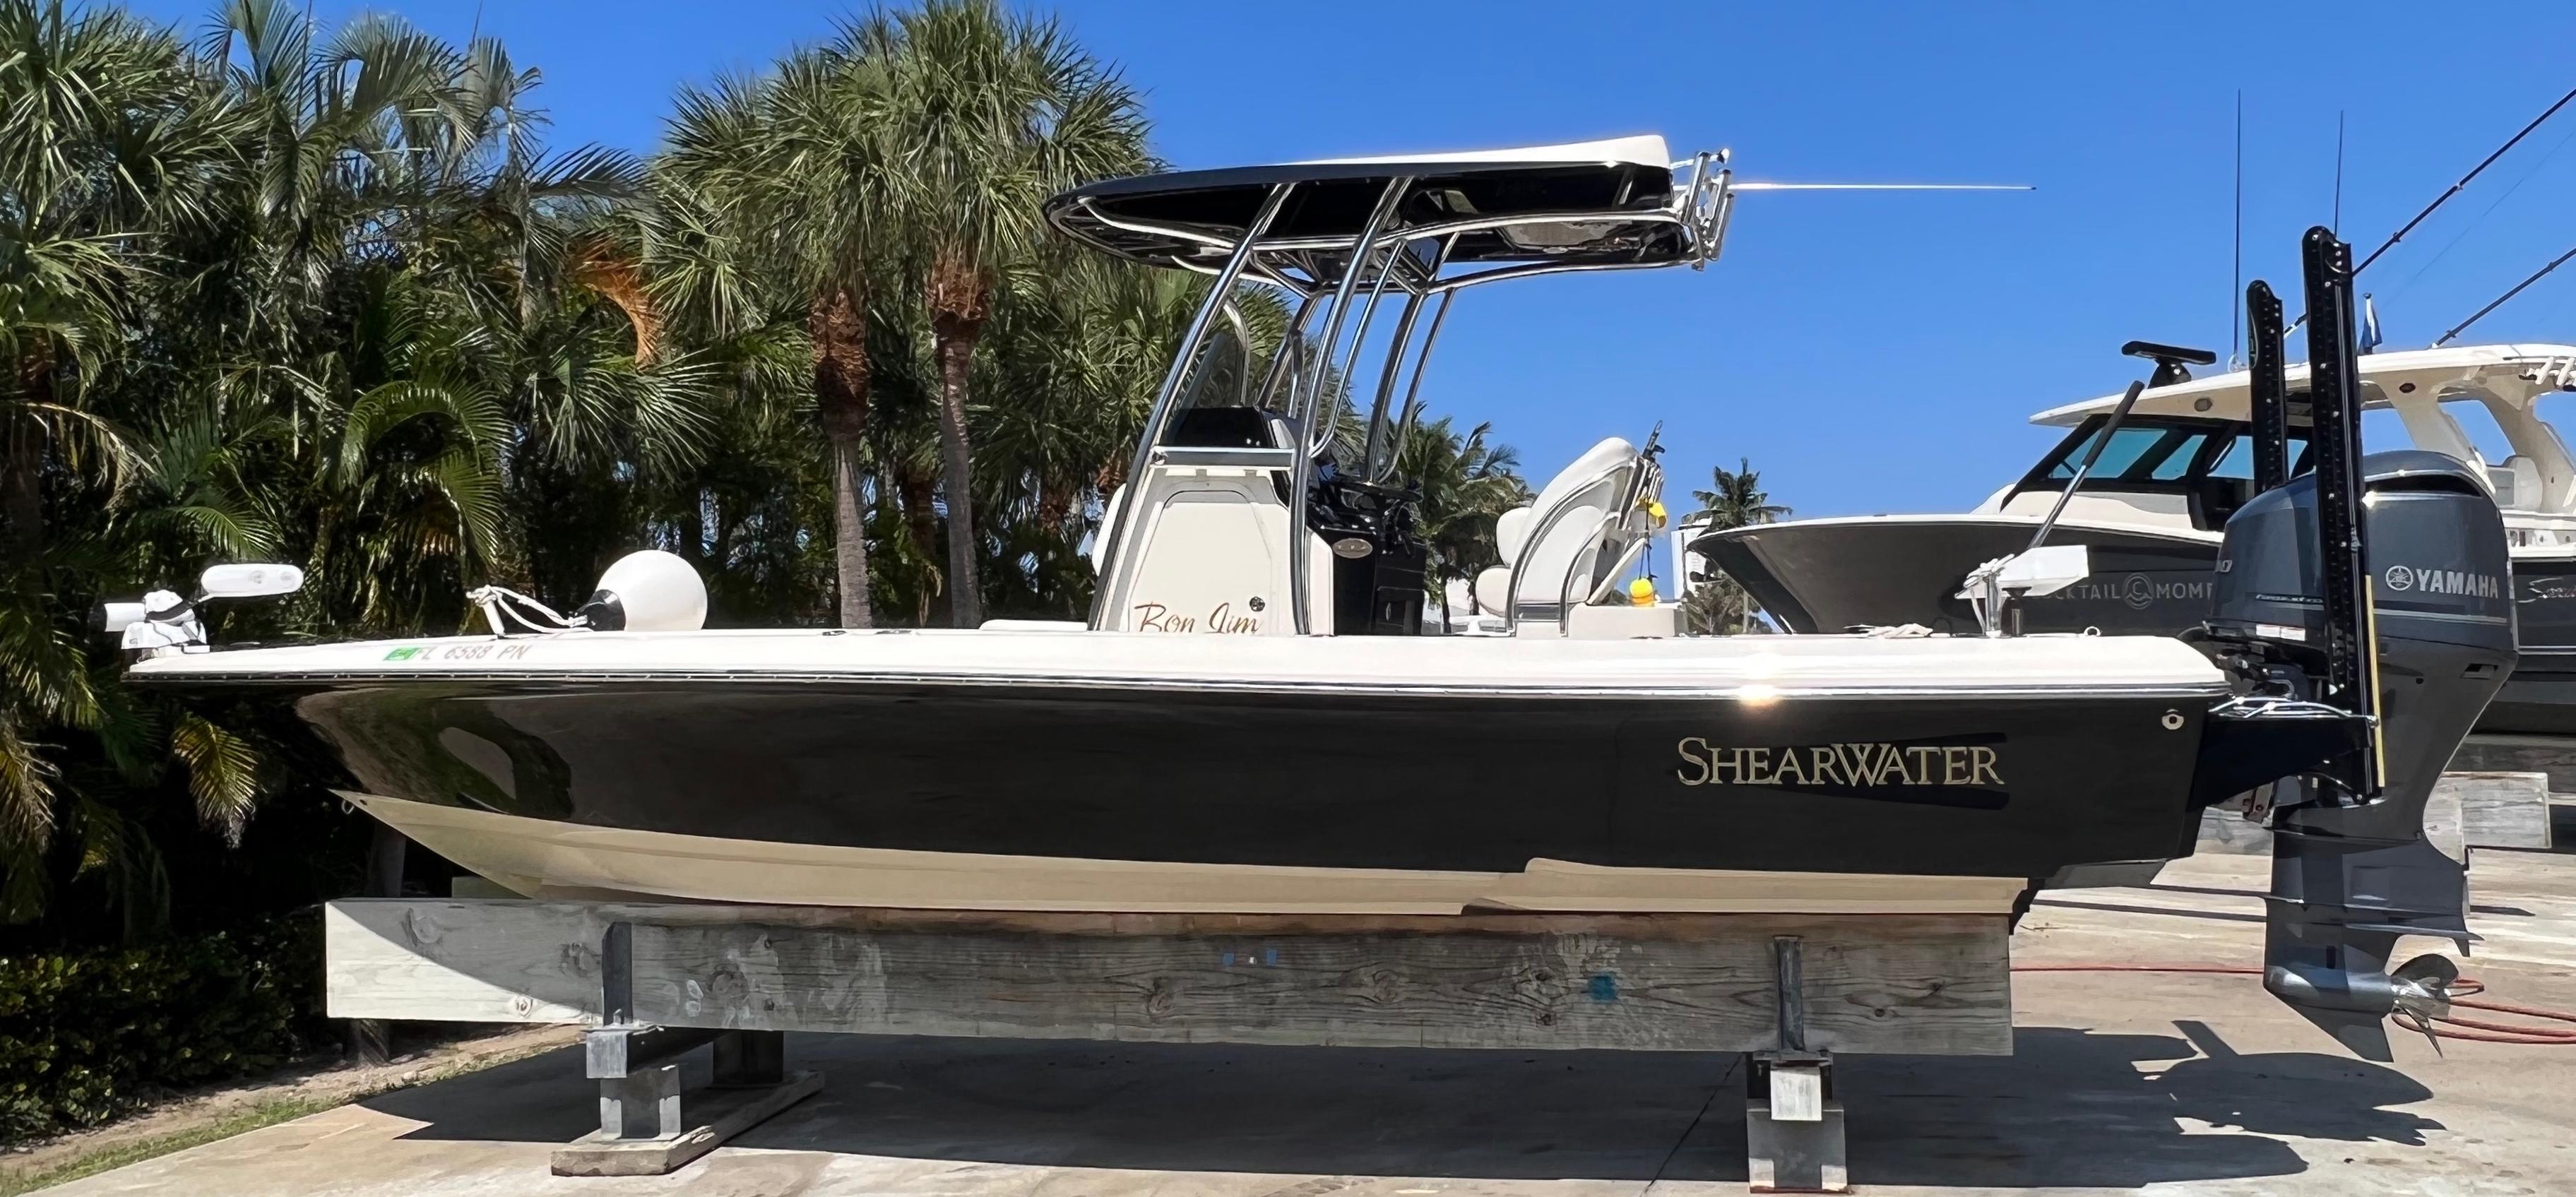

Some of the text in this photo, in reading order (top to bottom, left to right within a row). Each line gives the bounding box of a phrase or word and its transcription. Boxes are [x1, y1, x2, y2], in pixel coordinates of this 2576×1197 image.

[2416, 568, 2499, 599] YAMAHA
[497, 645, 533, 660] PN
[1677, 736, 2006, 787] SHEARWATER
